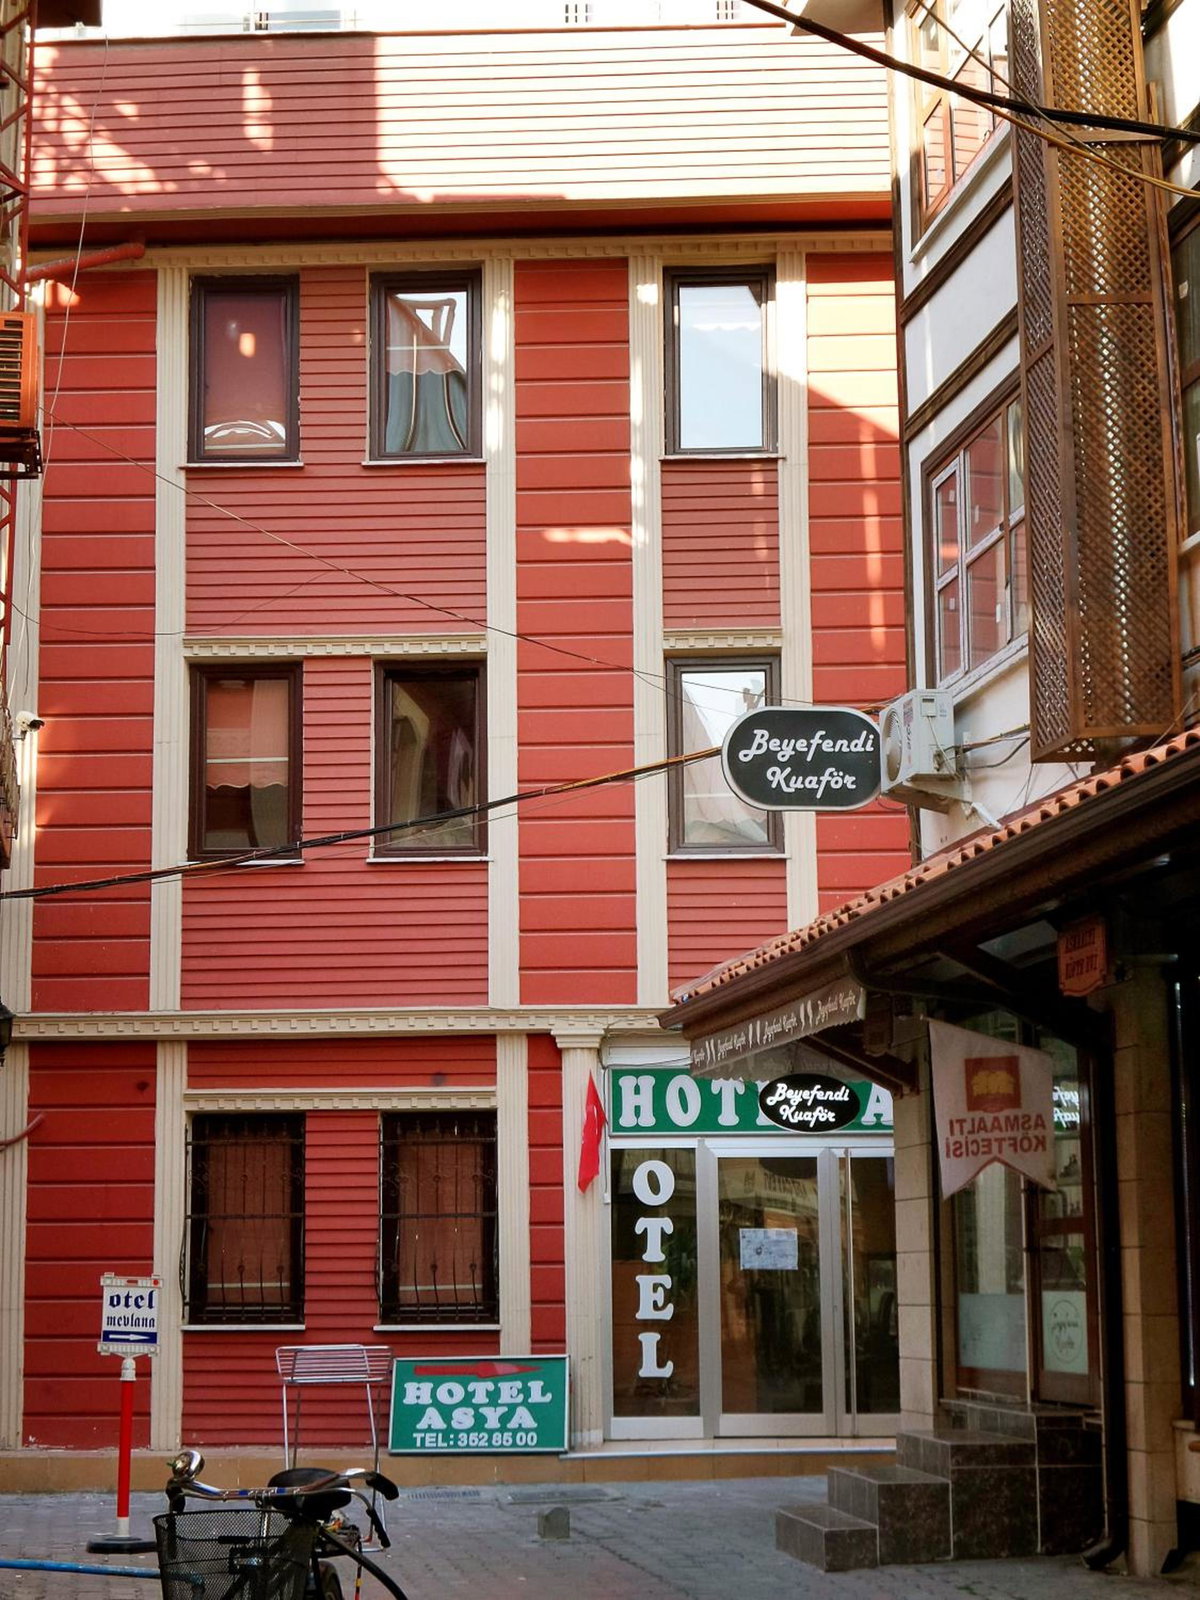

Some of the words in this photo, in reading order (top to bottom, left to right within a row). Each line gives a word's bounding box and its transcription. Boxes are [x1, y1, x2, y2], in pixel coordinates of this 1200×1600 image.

[738, 729, 875, 762] Beyefendi
[766, 766, 857, 799] Kuaför
[618, 1074, 775, 1127] HOT
[767, 1083, 850, 1106] Beyefendi
[779, 1105, 836, 1128] Kuaför
[632, 1159, 675, 1378] OTEL
[109, 1290, 156, 1310] otel
[106, 1313, 156, 1328] mevlana
[402, 1380, 553, 1405] HOTEL
[416, 1406, 538, 1430] ASYA
[413, 1433, 454, 1447] TEL:
[515, 1432, 538, 1446] 00
